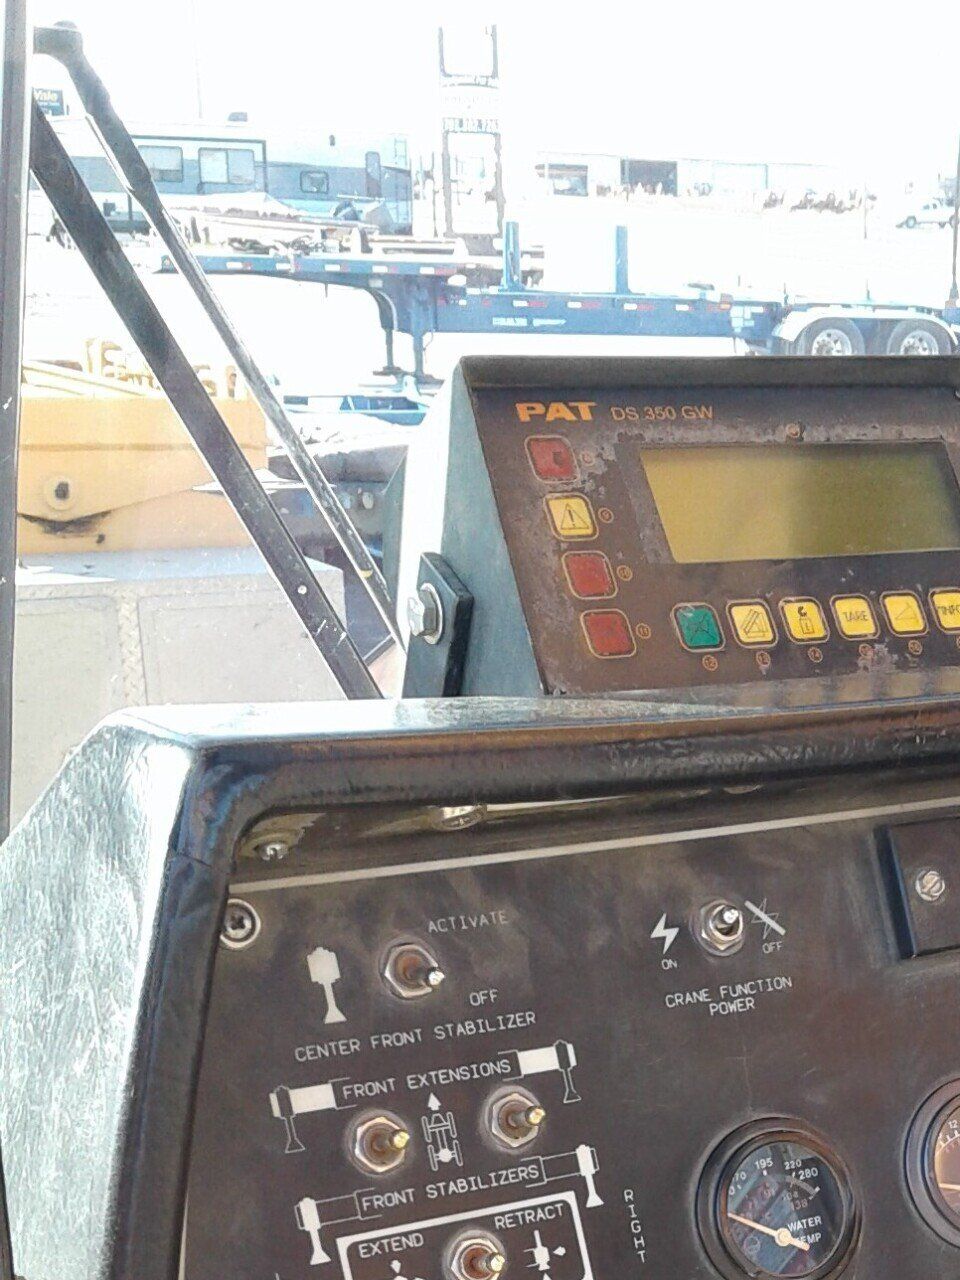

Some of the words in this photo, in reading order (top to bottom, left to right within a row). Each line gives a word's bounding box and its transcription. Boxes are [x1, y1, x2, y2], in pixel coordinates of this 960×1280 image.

[515, 402, 597, 422] PAT
[610, 407, 640, 421] DS
[645, 406, 677, 421] 350
[681, 406, 713, 420] GW
[843, 610, 868, 622] TARE
[428, 910, 508, 933] ACTIVATE
[762, 941, 783, 954] OFF
[661, 958, 678, 970] ON
[469, 988, 499, 1007] OFF
[665, 987, 711, 1008] CRANE
[719, 976, 793, 998] FUNCTION
[709, 998, 755, 1016] POWER
[295, 1038, 360, 1062] CENTER
[371, 1028, 423, 1049] FRONT
[434, 1012, 537, 1040] STABILIZER
[343, 1079, 396, 1100] FRONT
[407, 1059, 512, 1090] EXTENSIONS
[948, 1119, 958, 1129] 12
[755, 1158, 773, 1170] 195
[784, 1159, 802, 1170] 220
[798, 1168, 819, 1180] 280
[362, 1189, 415, 1212] FRONT
[425, 1165, 539, 1199] STABILIZERS
[494, 1204, 565, 1230] RETRACT
[623, 1189, 647, 1263] RIGHT
[788, 1216, 822, 1231] WATER
[358, 1232, 424, 1259] EXTEND
[794, 1232, 822, 1244] EMP
